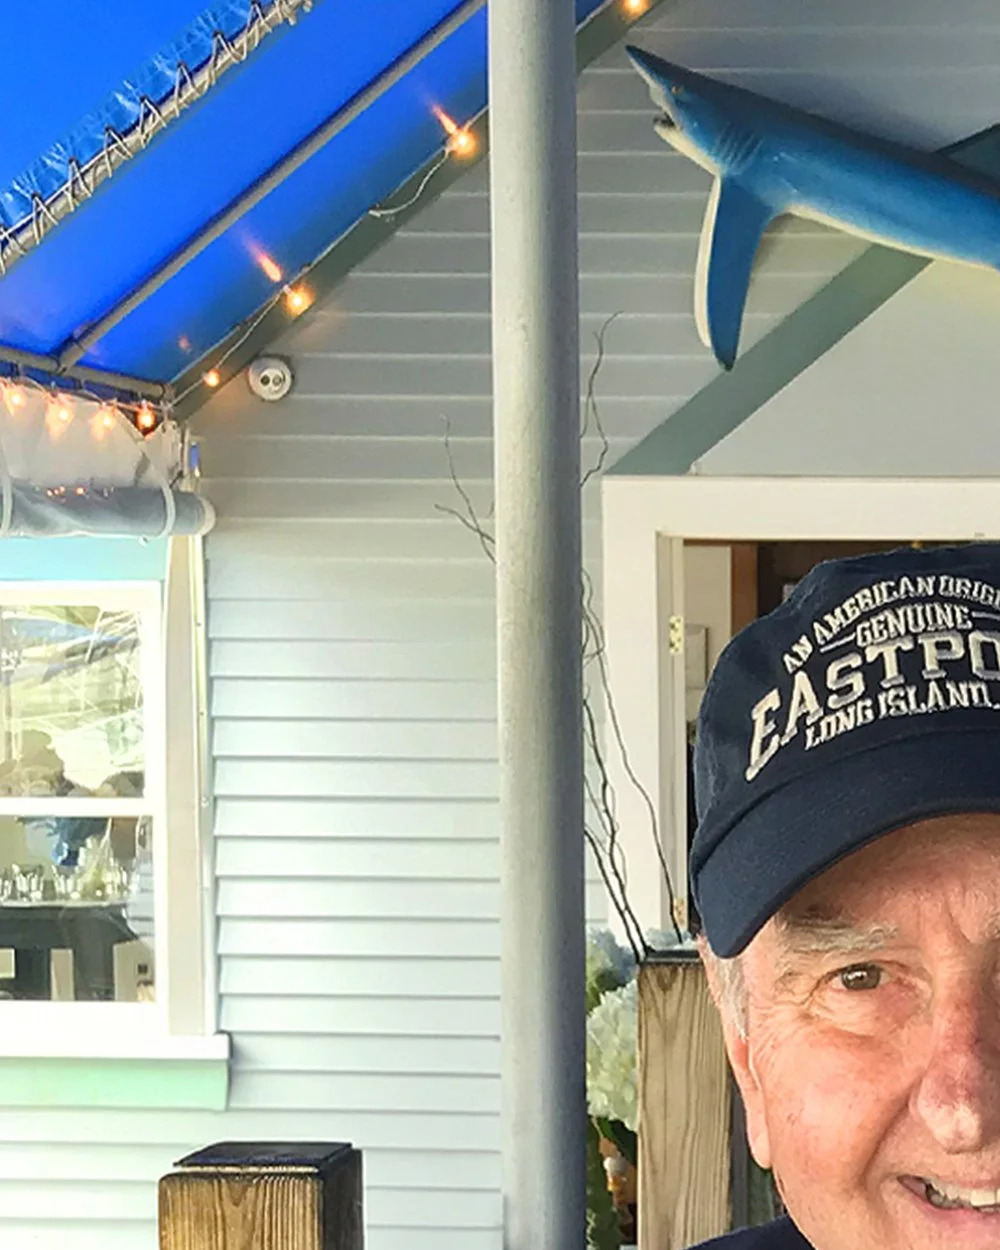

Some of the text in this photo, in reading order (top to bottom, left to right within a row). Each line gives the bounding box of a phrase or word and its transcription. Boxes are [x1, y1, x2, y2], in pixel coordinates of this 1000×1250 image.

[782, 634, 814, 674] AN
[812, 575, 936, 645] AMERICAN
[855, 604, 973, 648] GENUINE
[805, 697, 874, 750] LONG
